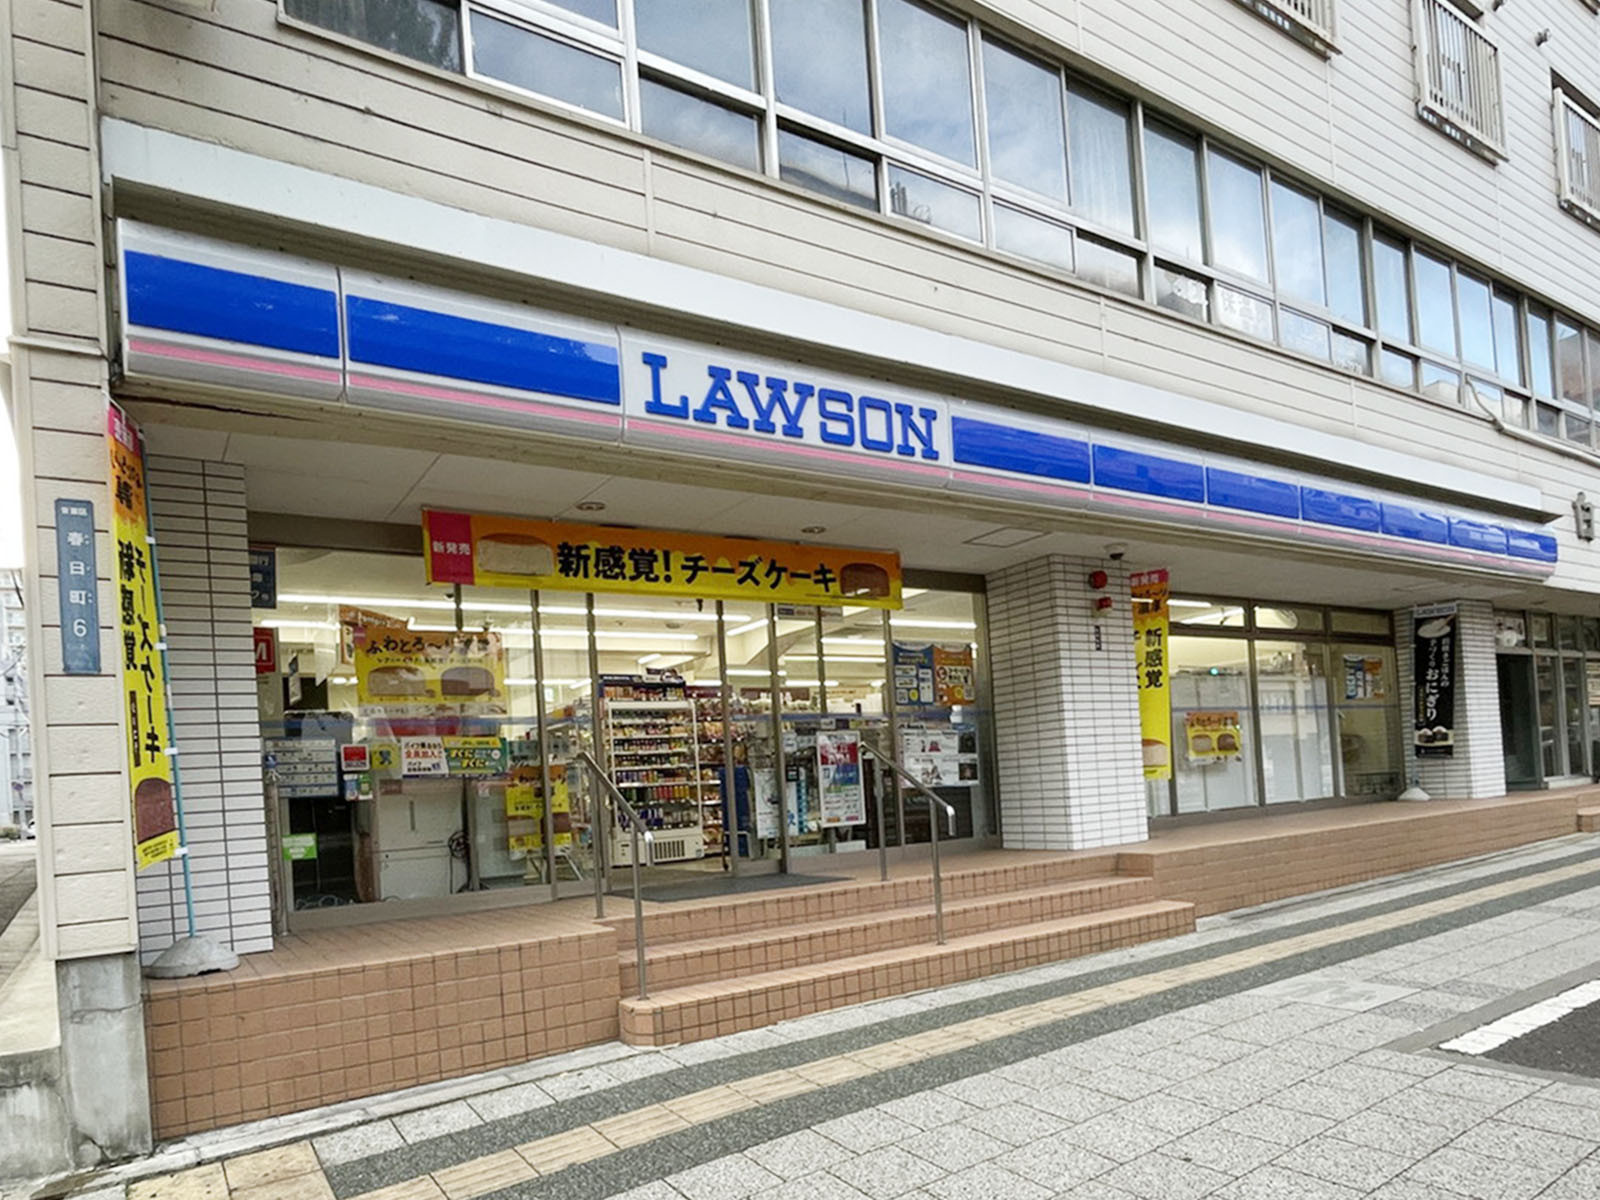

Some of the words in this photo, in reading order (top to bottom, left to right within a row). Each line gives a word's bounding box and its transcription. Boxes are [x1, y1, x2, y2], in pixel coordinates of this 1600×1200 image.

[642, 352, 939, 460] LAWSON
[557, 541, 837, 593] 新感覚!チーズケーキ
[1145, 627, 1163, 688] 新感覚
